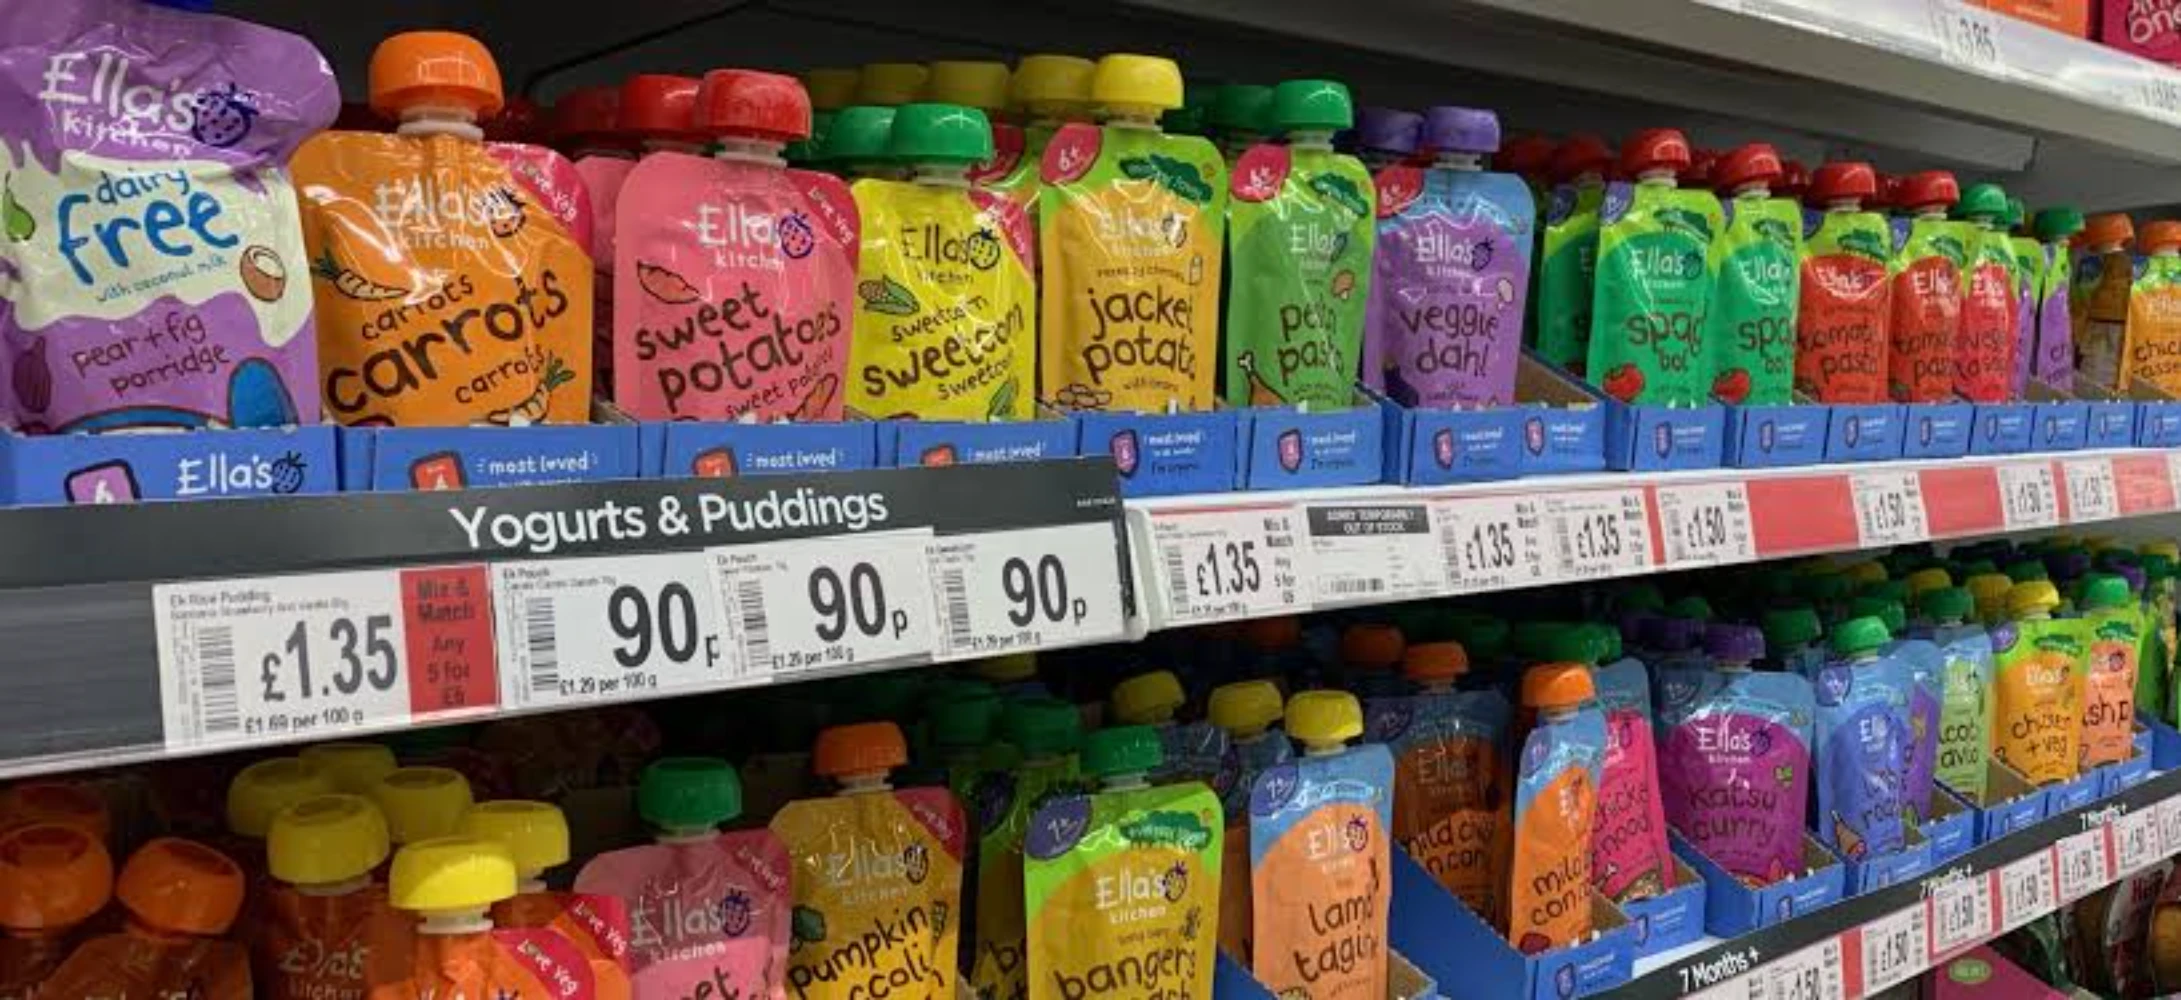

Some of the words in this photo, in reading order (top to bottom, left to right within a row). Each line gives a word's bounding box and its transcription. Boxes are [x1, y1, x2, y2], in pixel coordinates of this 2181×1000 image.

[38, 50, 196, 132] Ella's
[96, 166, 191, 206] dairy
[57, 190, 240, 286] free
[361, 272, 475, 342] carrots
[634, 280, 769, 362] sweet
[1399, 301, 1500, 342] veggie
[326, 269, 570, 414] carrots
[1415, 336, 1492, 380] dahl
[109, 342, 231, 399] porridge
[455, 343, 546, 405] carrots
[176, 451, 274, 495] Ella's
[487, 454, 538, 476] most
[448, 497, 647, 553] Yogurts
[658, 495, 690, 538] &
[702, 487, 889, 533] Puddings
[1465, 522, 1516, 571] £1.35
[1577, 512, 1622, 560] £1.35
[1687, 505, 1727, 548] £1.50
[1001, 553, 1089, 628] 90p
[1197, 540, 1261, 598] £1.35
[416, 600, 477, 623] Match
[808, 561, 909, 643] 90p
[260, 613, 400, 703] £1.35
[430, 635, 467, 656] Any
[559, 677, 597, 696] £1.29
[598, 677, 620, 696] per
[623, 673, 647, 690] 100
[291, 712, 317, 732] per
[321, 707, 351, 727] 100
[1690, 780, 1778, 811] katsu
[516, 938, 553, 973] Love
[553, 961, 581, 997] Veg
[786, 906, 930, 1000] pumpkin
[1678, 966, 1690, 994] 7
[1691, 951, 1750, 991] Months
[1749, 946, 1761, 964] +
